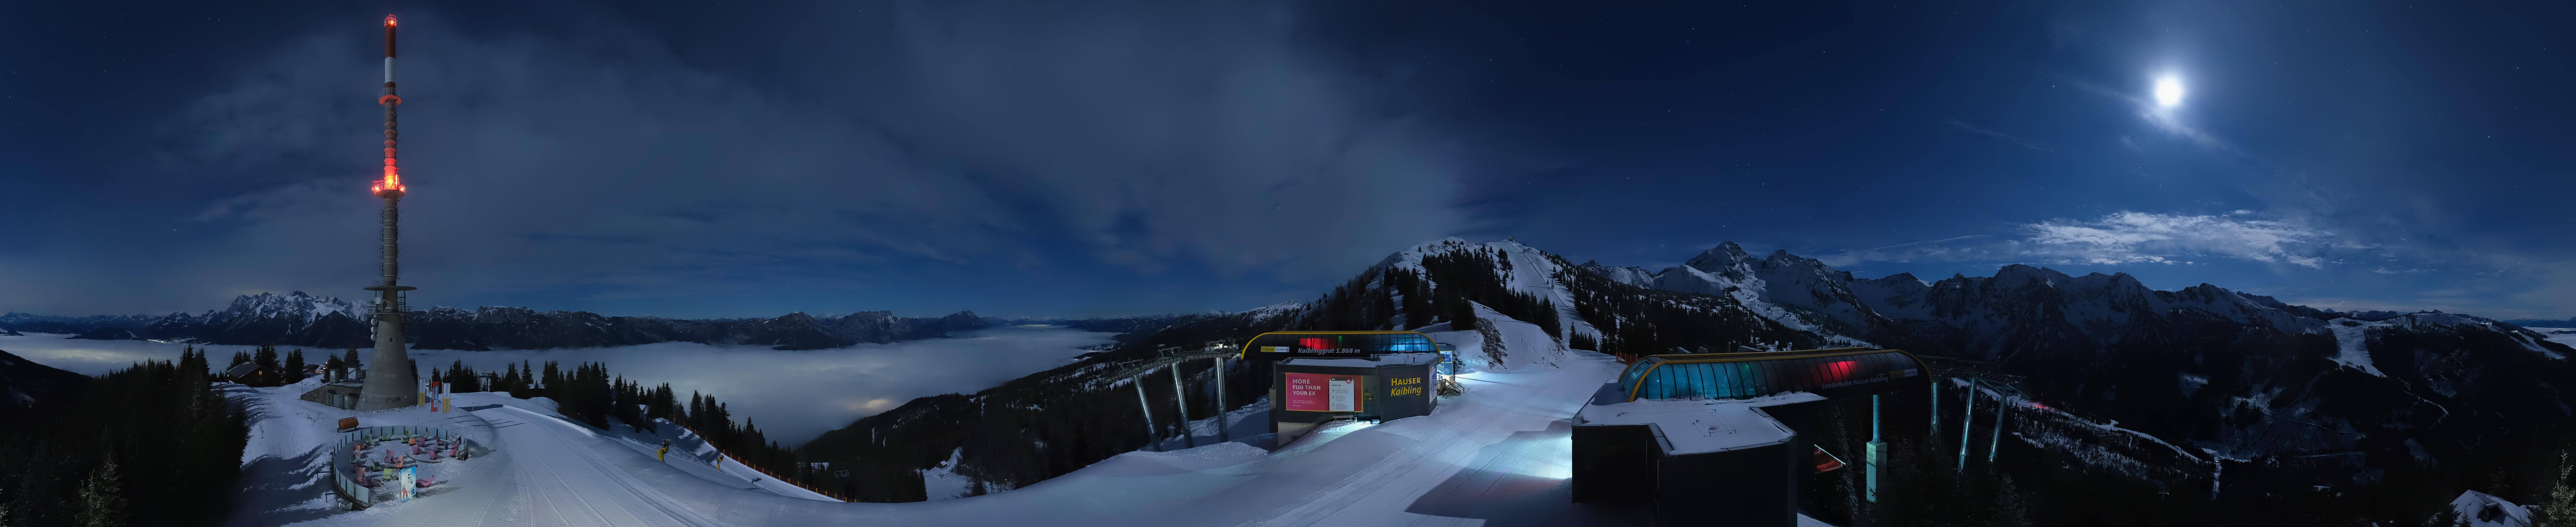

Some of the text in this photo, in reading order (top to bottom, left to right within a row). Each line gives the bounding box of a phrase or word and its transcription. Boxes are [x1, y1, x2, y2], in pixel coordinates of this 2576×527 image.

[1391, 377, 1421, 386] HAUSER
[1822, 380, 1852, 389] Senderbahn
[1391, 386, 1421, 396] Kaibling
